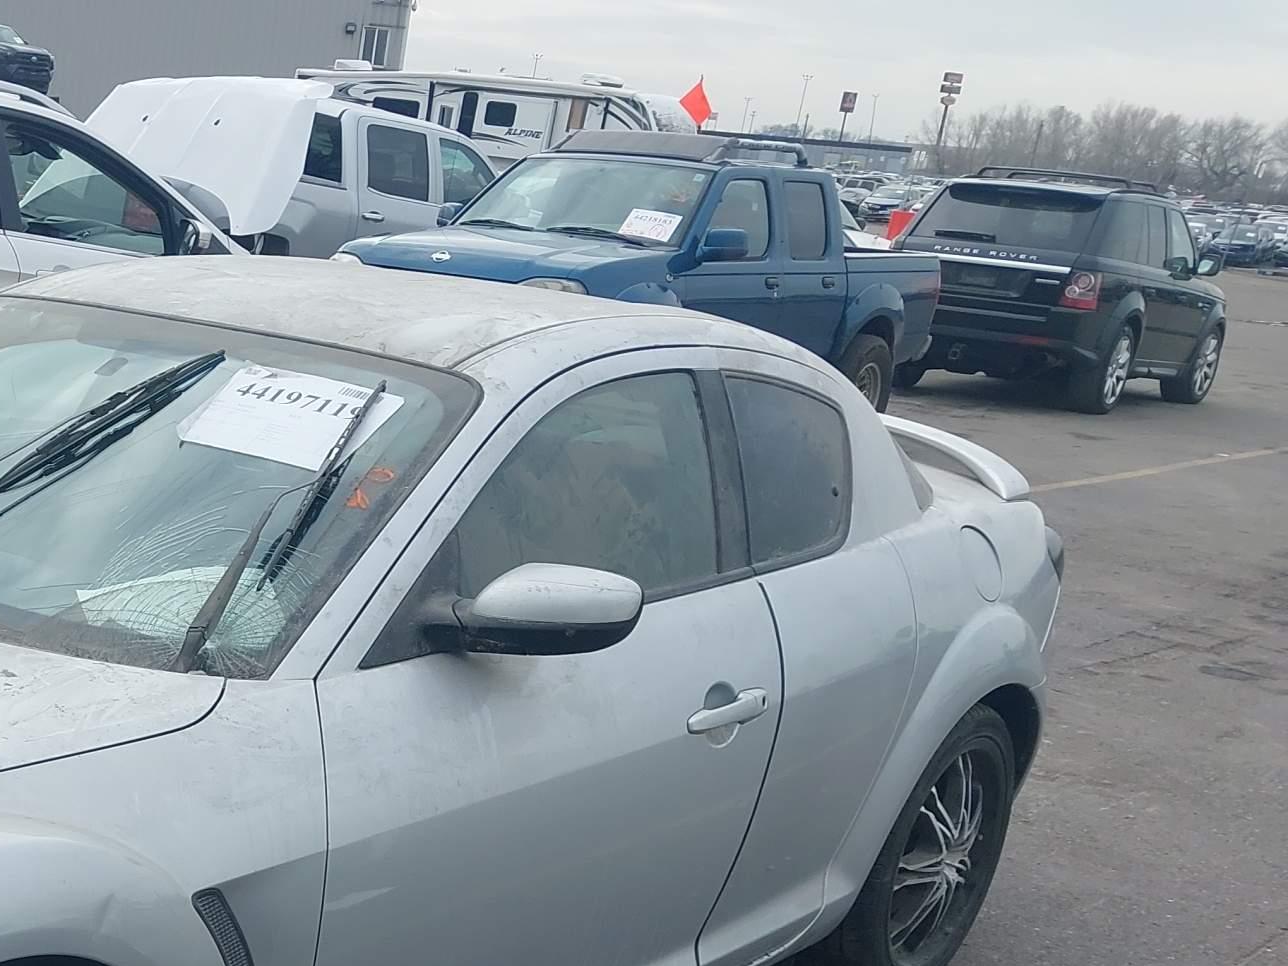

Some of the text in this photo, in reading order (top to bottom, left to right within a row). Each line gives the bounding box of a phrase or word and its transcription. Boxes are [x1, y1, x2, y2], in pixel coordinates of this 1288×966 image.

[504, 128, 543, 139] ALPINE
[934, 245, 1039, 261] RANGE ROVER
